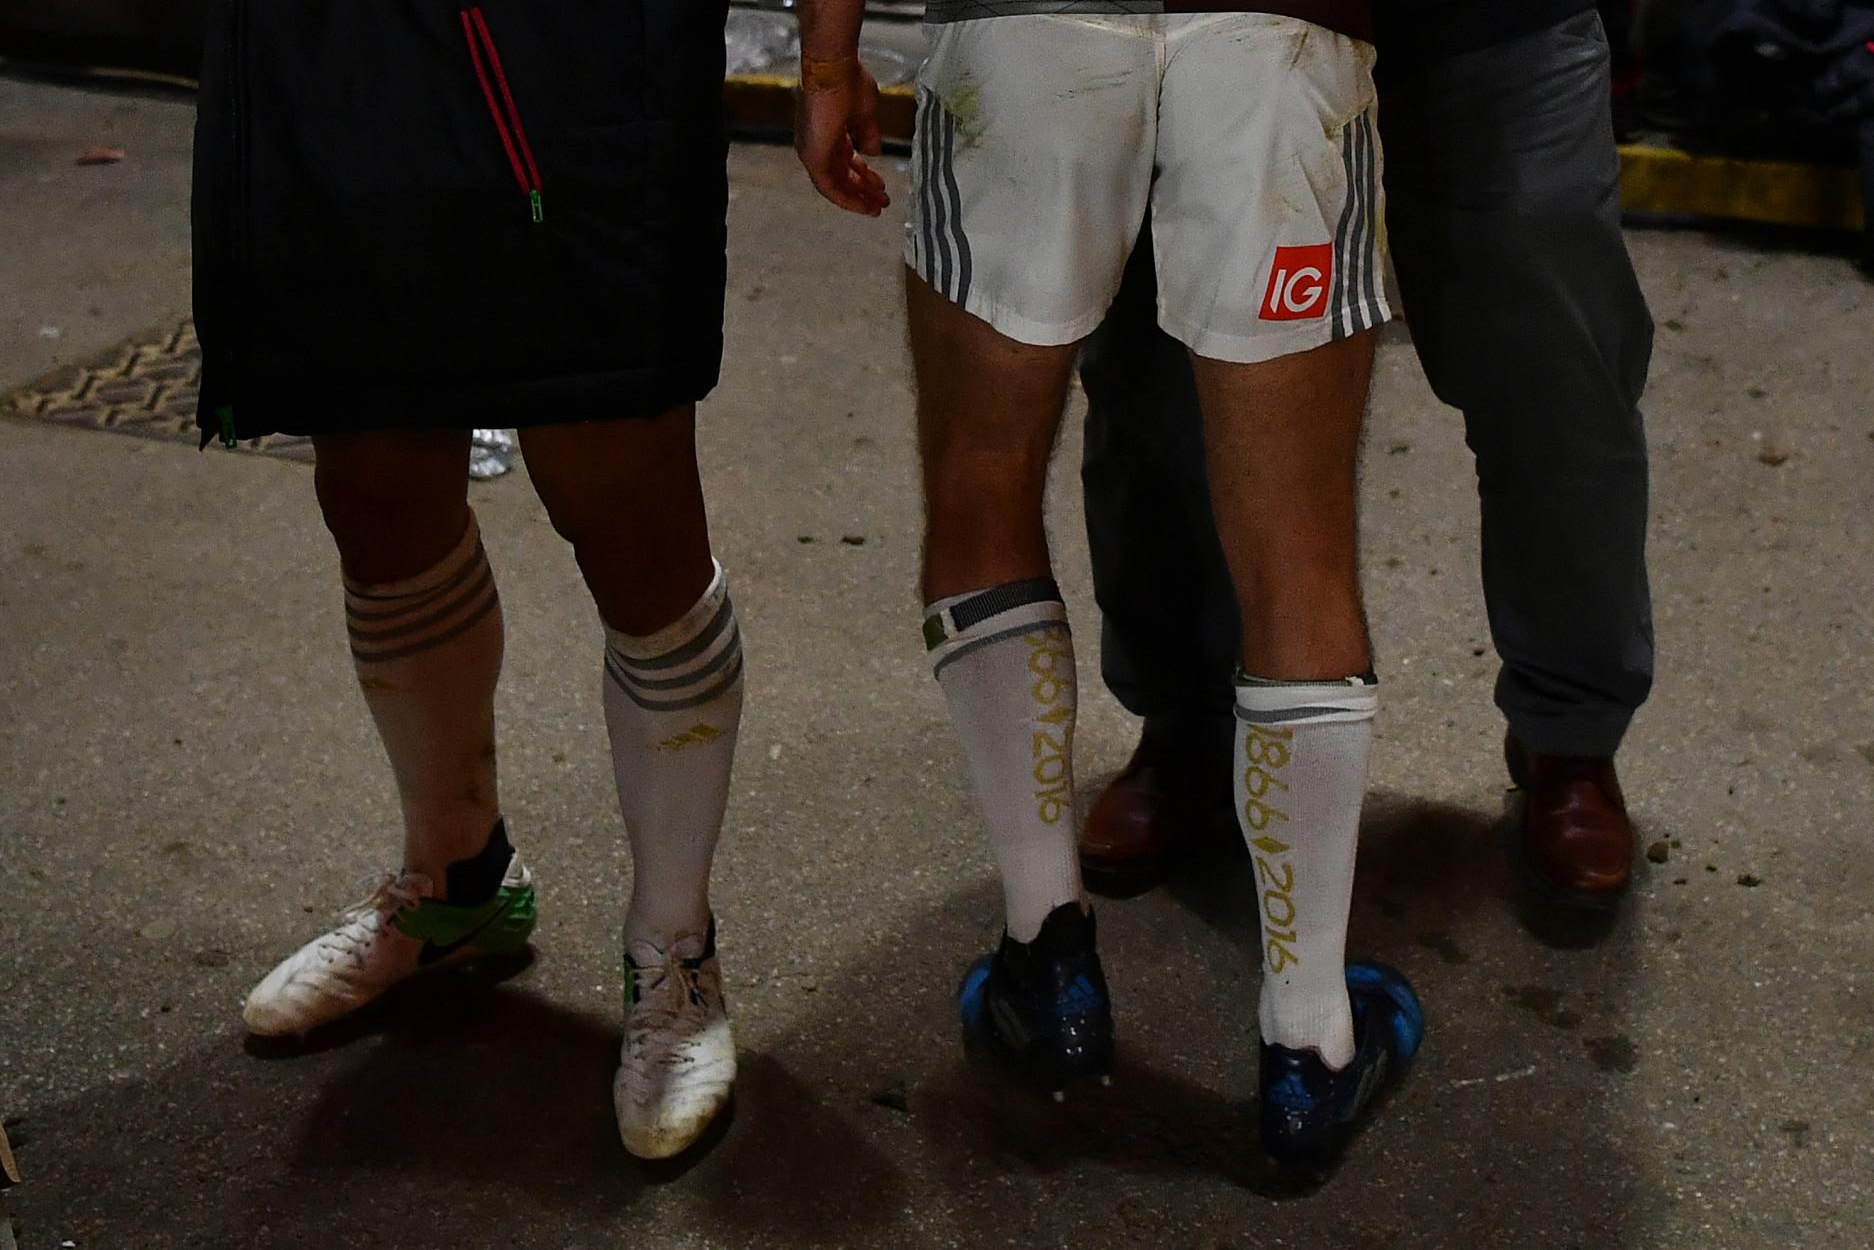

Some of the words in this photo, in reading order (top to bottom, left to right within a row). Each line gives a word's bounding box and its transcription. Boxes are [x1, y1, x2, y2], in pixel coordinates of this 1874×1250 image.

[1269, 266, 1323, 314] IG
[1245, 723, 1294, 831] 1866
[1255, 855, 1299, 975] 2016
